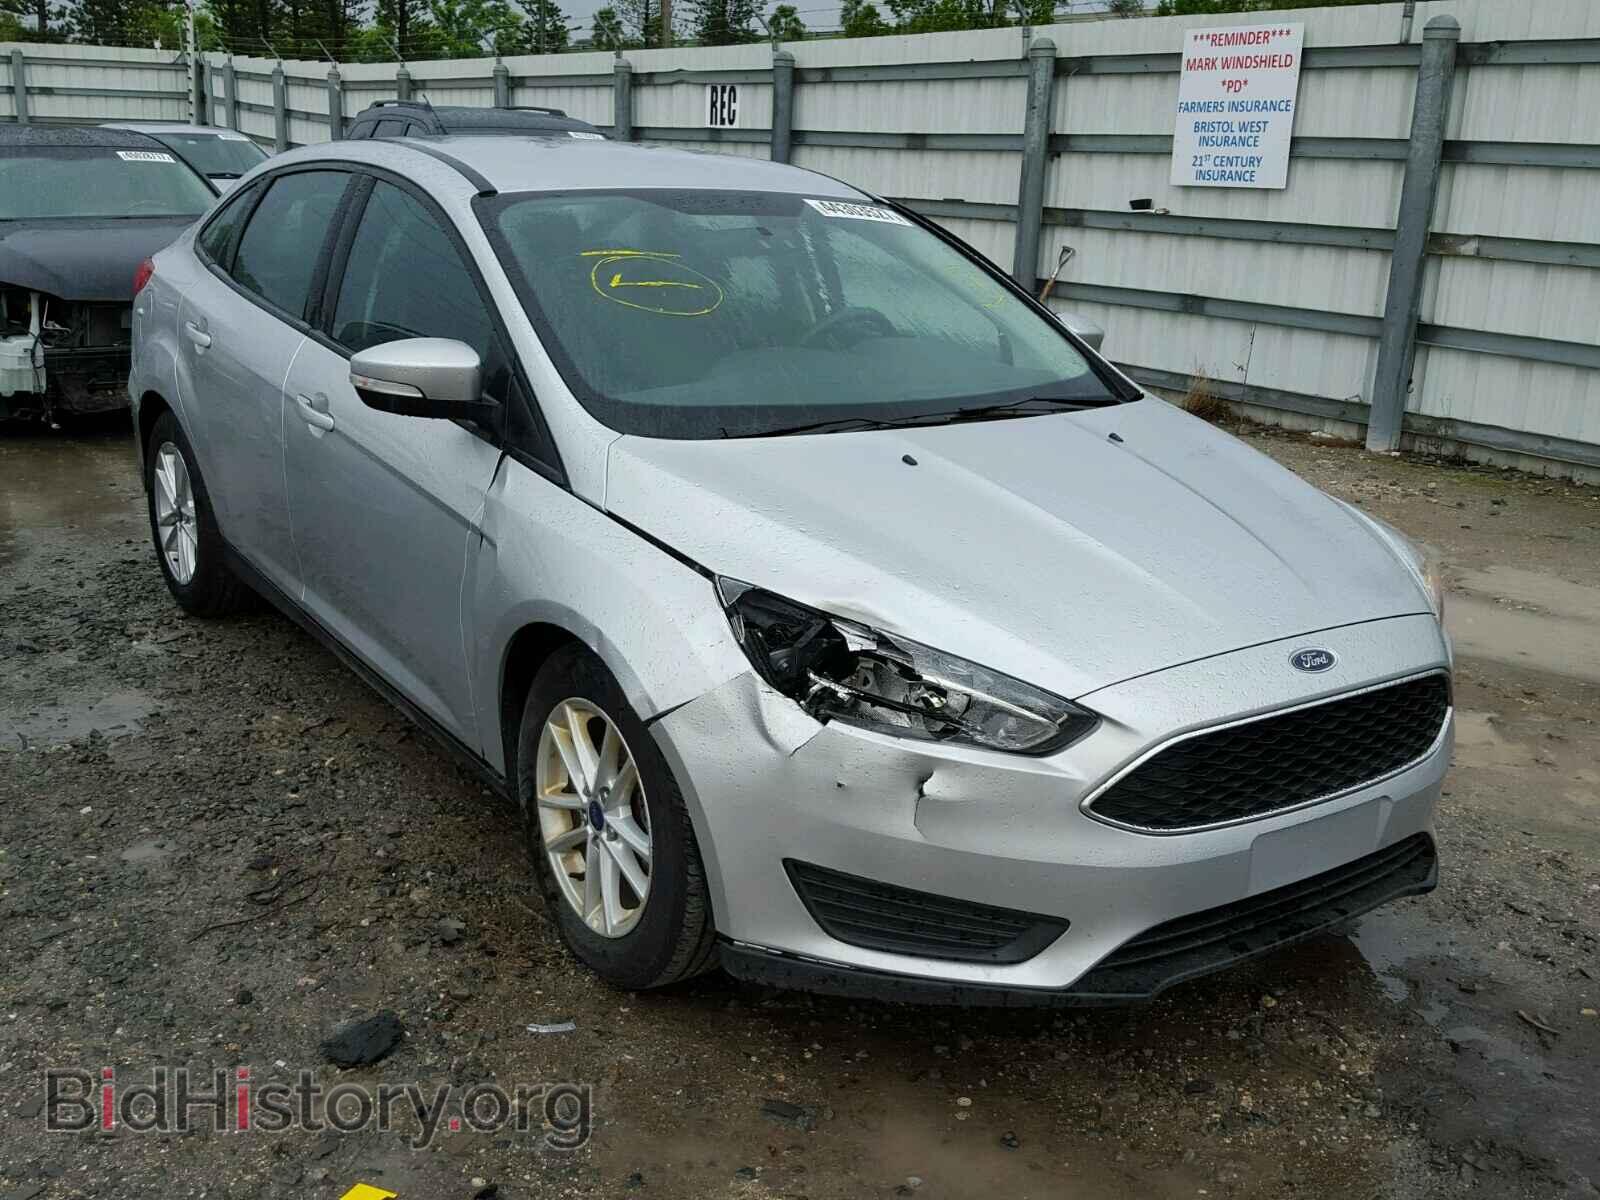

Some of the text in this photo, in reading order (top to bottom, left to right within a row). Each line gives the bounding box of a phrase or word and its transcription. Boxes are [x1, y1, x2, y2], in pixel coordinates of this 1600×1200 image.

[1186, 53, 1293, 71] MARK WINDSHIELD
[710, 85, 736, 126] REC
[1178, 99, 1292, 113] FARMERS INSURANCE
[1193, 120, 1269, 133] BRISTOL WEST
[1198, 135, 1260, 148] INSURANCE
[1213, 155, 1263, 168] CENTURY
[1195, 169, 1256, 182] INSURANCE
[1301, 652, 1329, 668] Ford
